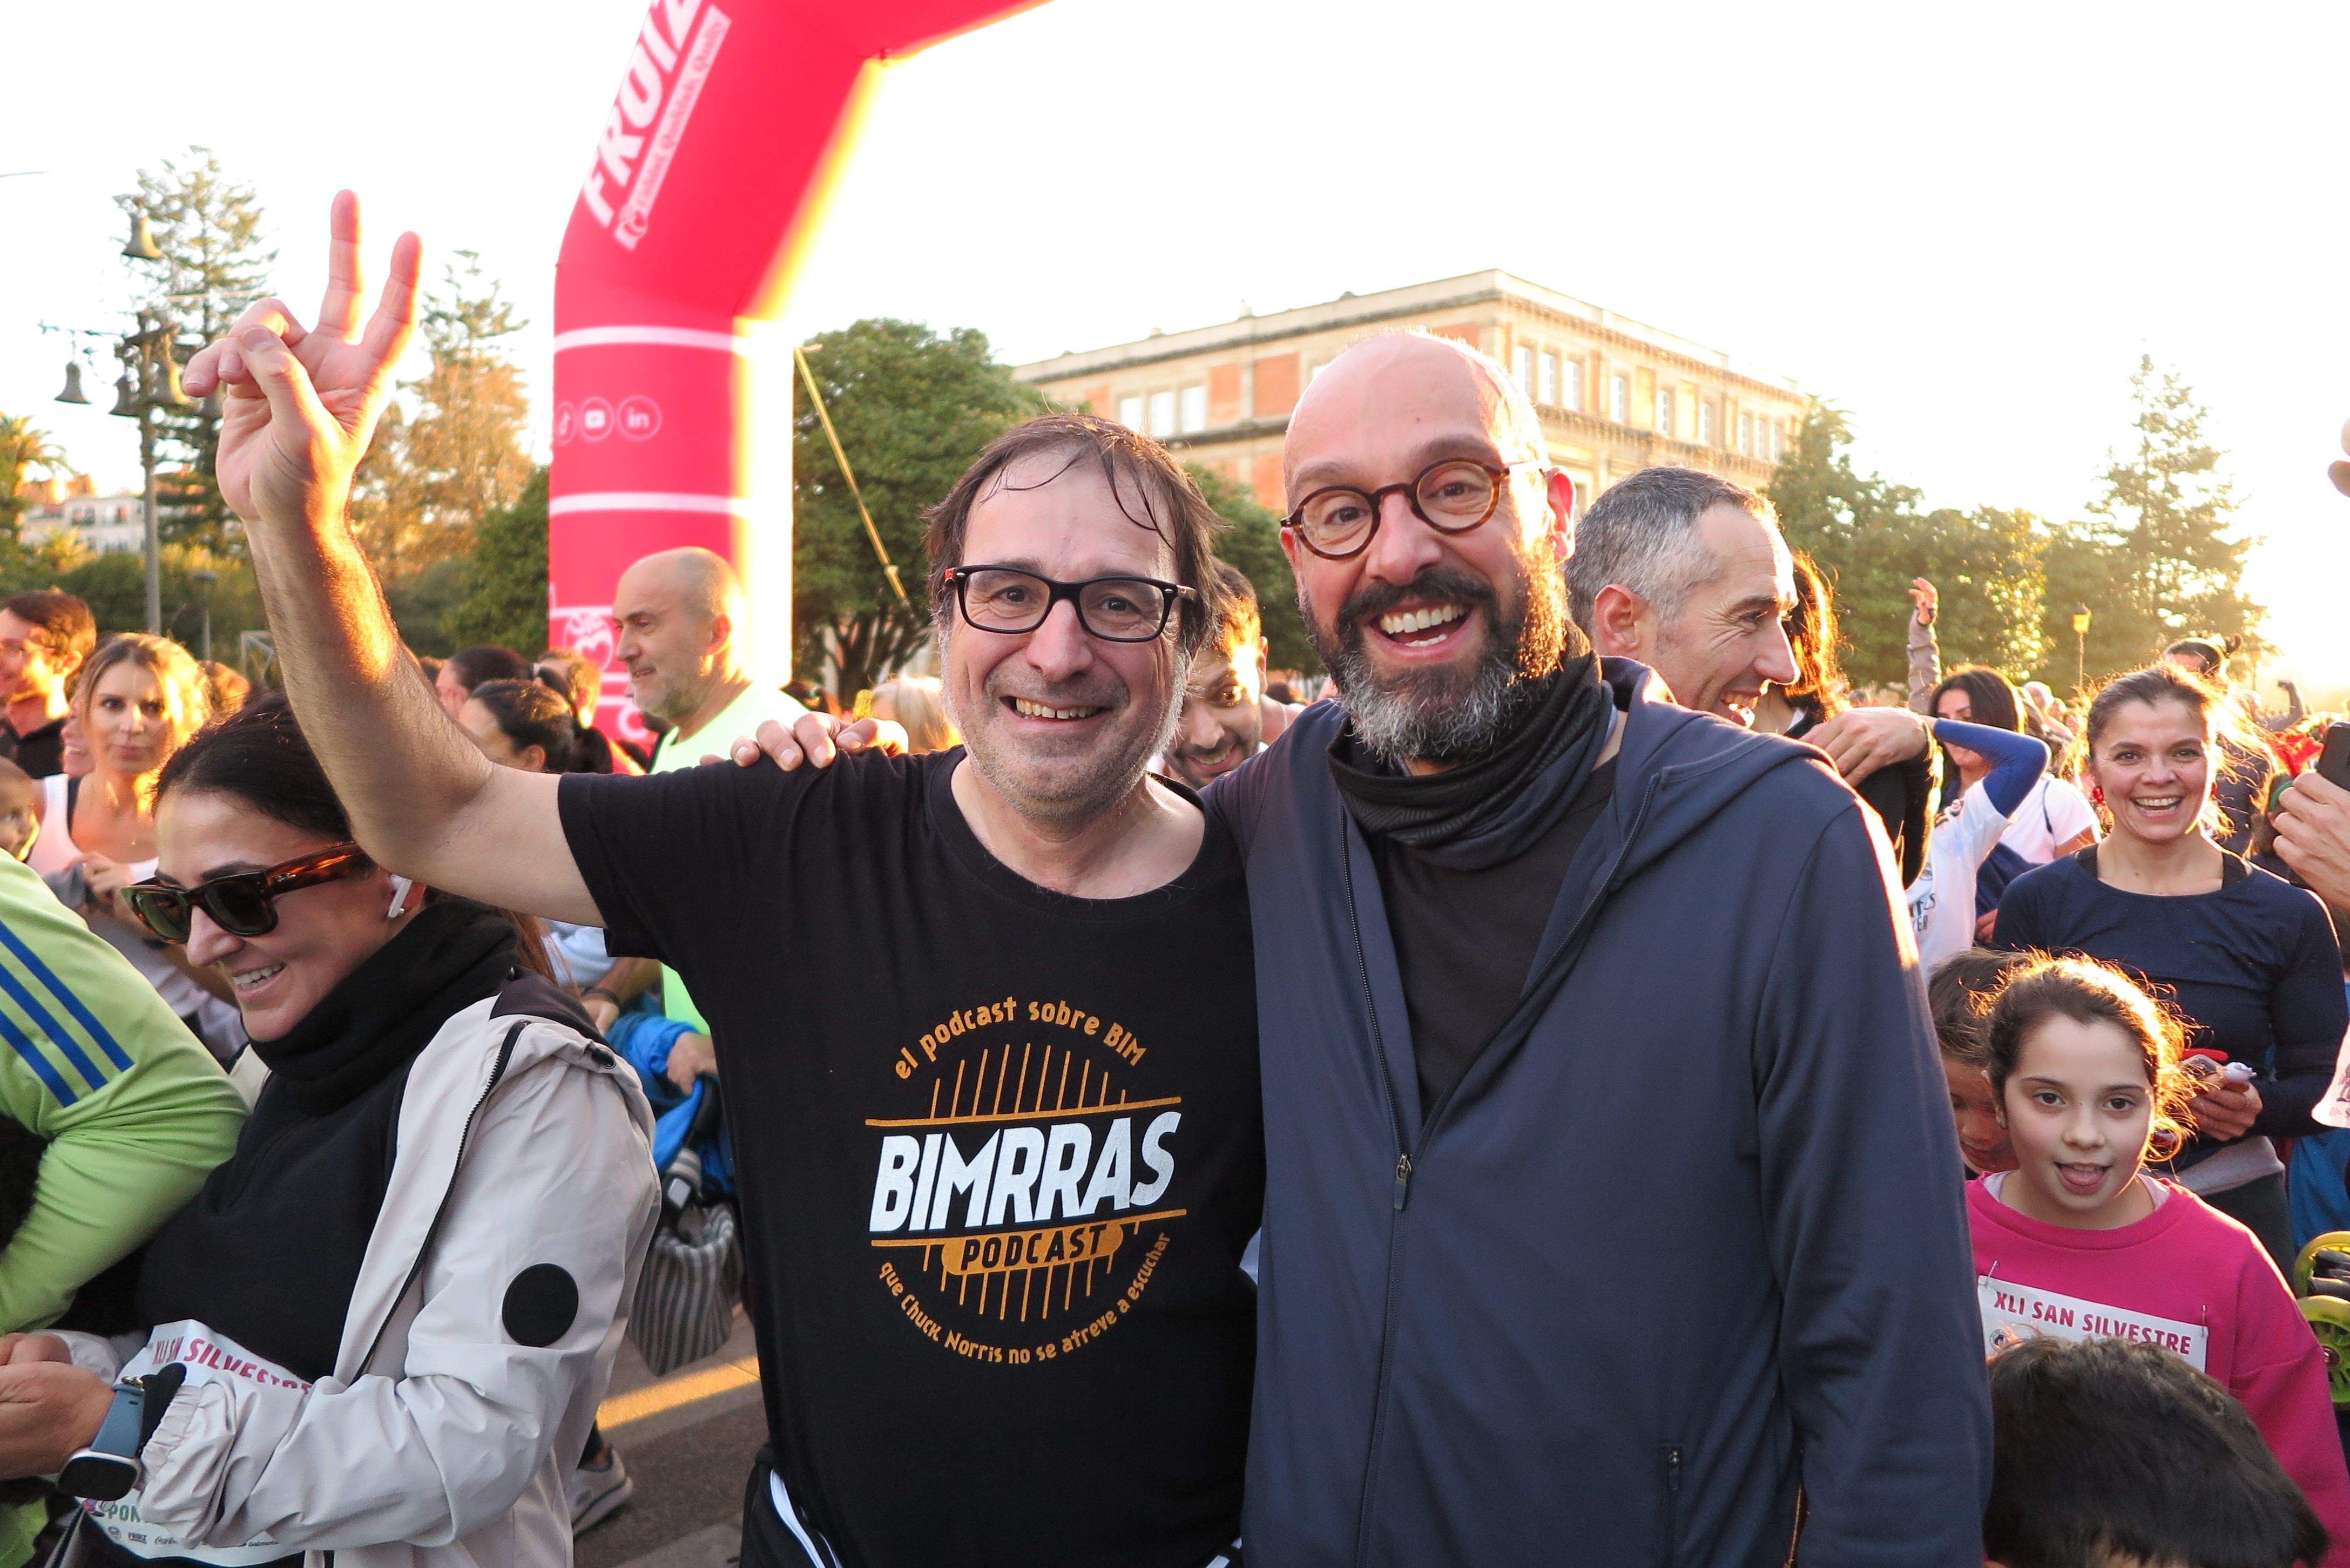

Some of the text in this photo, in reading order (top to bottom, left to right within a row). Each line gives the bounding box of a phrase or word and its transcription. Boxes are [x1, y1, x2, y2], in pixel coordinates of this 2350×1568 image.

[583, 0, 702, 229] FROIZ
[895, 996, 1147, 1079] el podcast sobre BIM
[869, 1111, 1182, 1232] BIMRRAS
[961, 1224, 1111, 1270] PODCAST
[879, 1233, 1171, 1364] que Chuck Norris no se atreve a escuchar
[1994, 1291, 2192, 1355] XLI SAN SILVESTRE
